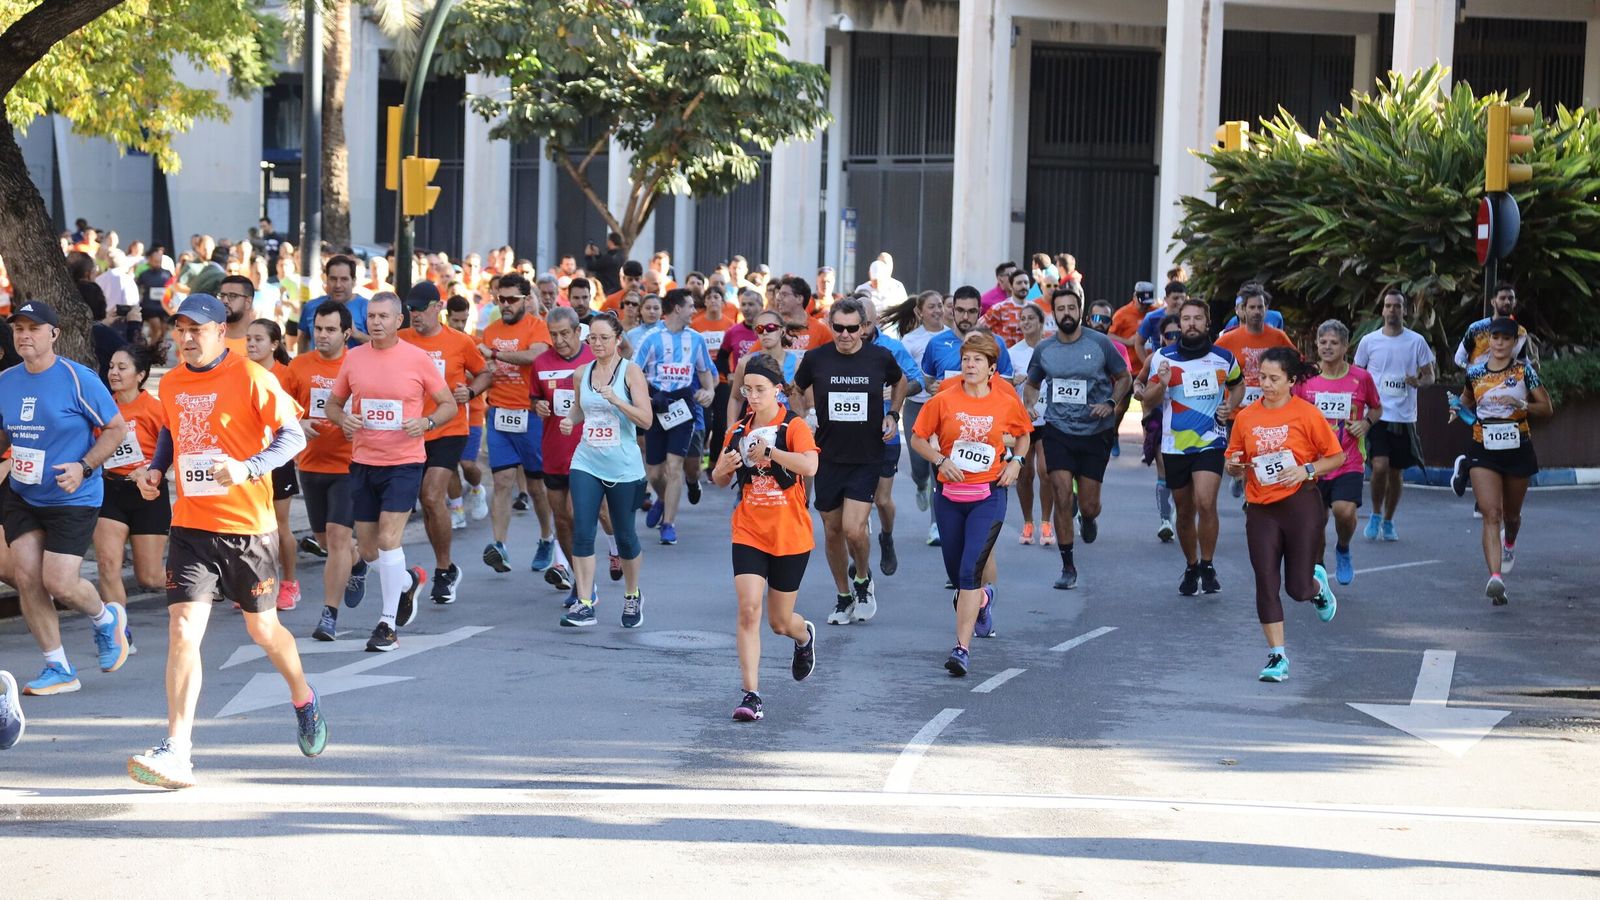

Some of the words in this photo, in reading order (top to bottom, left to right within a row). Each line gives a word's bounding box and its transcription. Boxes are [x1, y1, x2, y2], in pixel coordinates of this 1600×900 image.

[1192, 379, 1209, 389] 94
[1057, 386, 1080, 396] 247
[834, 402, 861, 412] 899
[1321, 402, 1345, 412] 372
[367, 410, 395, 421] 290
[500, 414, 521, 425] 166
[663, 407, 684, 422] 515
[588, 428, 613, 438] 733
[1488, 432, 1517, 441] 1025
[112, 443, 133, 457] 85
[958, 448, 991, 465] 1005
[1265, 461, 1284, 475] 55
